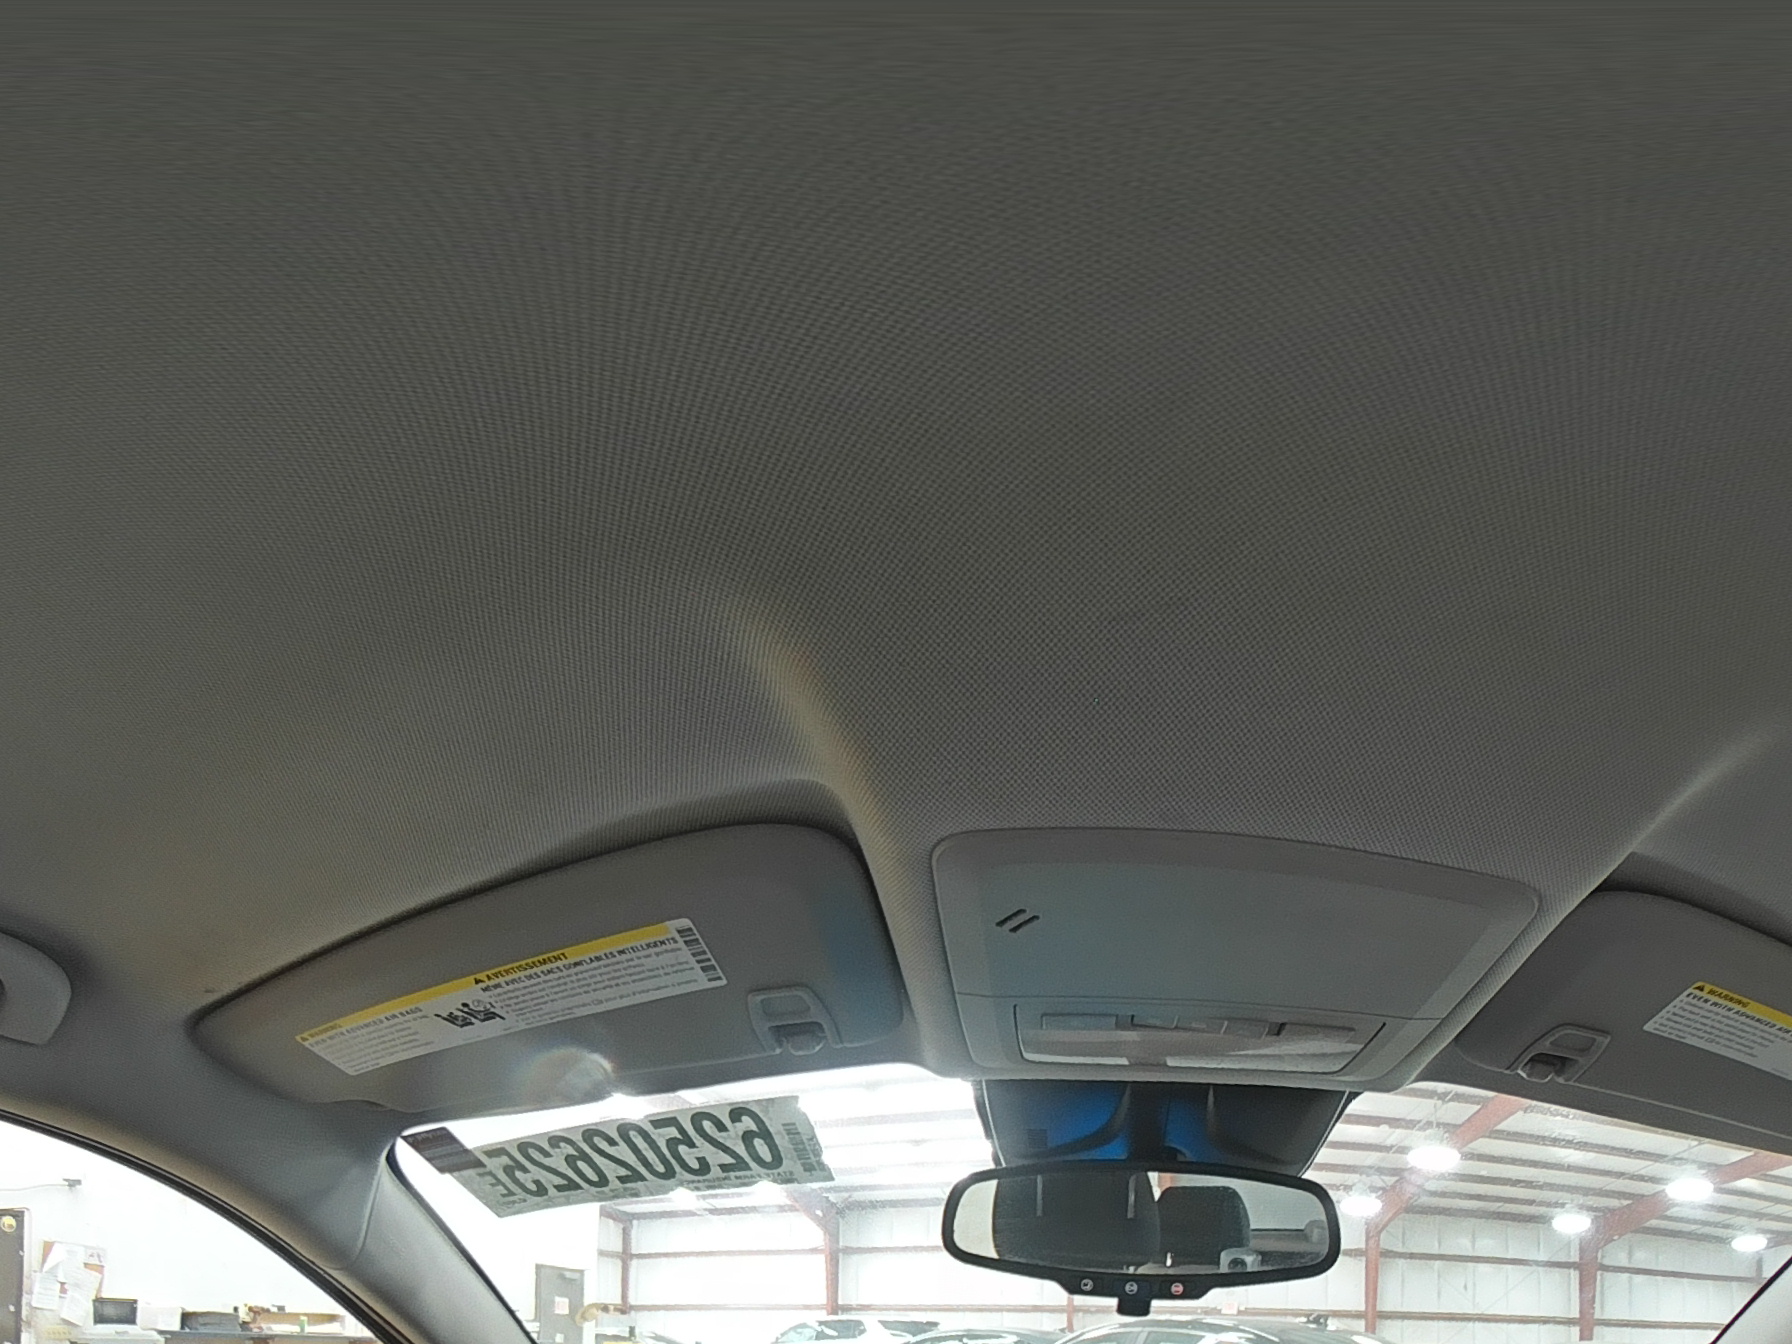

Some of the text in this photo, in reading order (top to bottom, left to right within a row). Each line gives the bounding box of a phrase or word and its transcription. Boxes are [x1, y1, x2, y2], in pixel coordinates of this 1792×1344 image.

[616, 937, 679, 957] INTELLIGENTS
[485, 952, 569, 981] AVERTISSEMENT
[1706, 987, 1752, 1008] WARNING
[1686, 992, 1711, 1004] EVEN
[1711, 1001, 1735, 1013] WITH
[1733, 1009, 1777, 1029] ADVANCED
